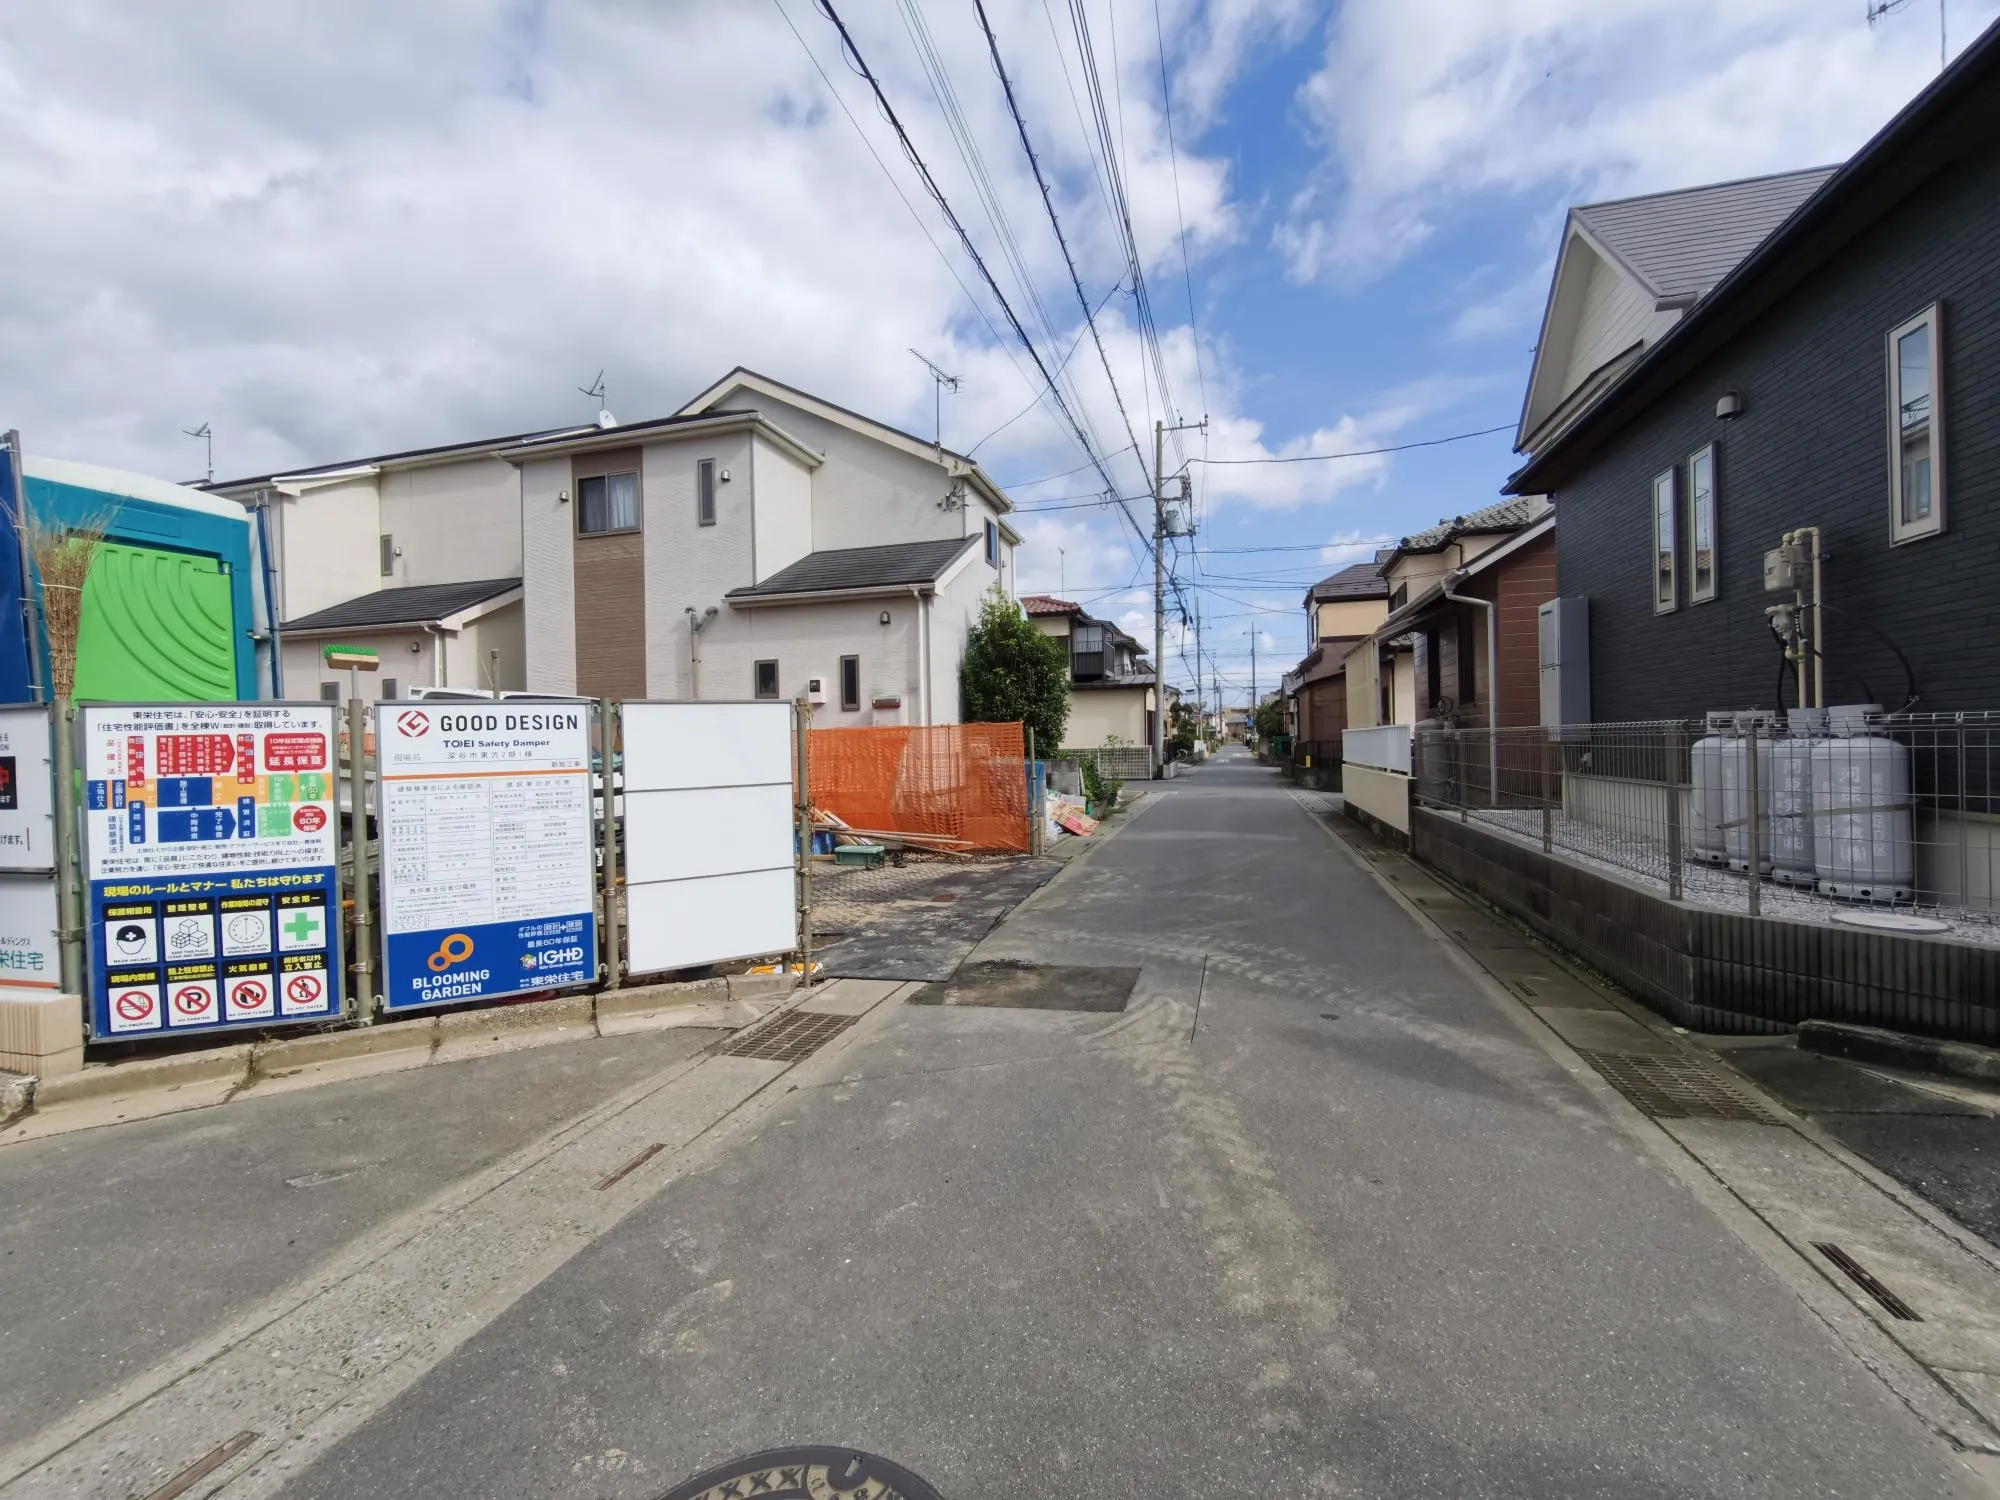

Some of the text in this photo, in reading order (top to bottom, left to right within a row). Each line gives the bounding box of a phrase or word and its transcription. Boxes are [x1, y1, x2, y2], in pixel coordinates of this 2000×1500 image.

[441, 714, 578, 731] GOOD DESIGN
[478, 740, 510, 748] Safety
[513, 739, 551, 748] Damper
[269, 755, 323, 766] 延長保証
[96, 783, 105, 808] 土地仕入
[1, 835, 24, 845] げます。
[104, 873, 325, 897] 現場のルールとマナー 私たちは守ります
[282, 894, 321, 905] 安全第一
[283, 954, 322, 964] 関係者以外
[538, 947, 583, 965] IGHD
[284, 962, 323, 972] 立入禁止
[412, 969, 490, 990] BLOOMING
[531, 970, 584, 987] 東栄住宅
[421, 982, 482, 1001] GARDEN
